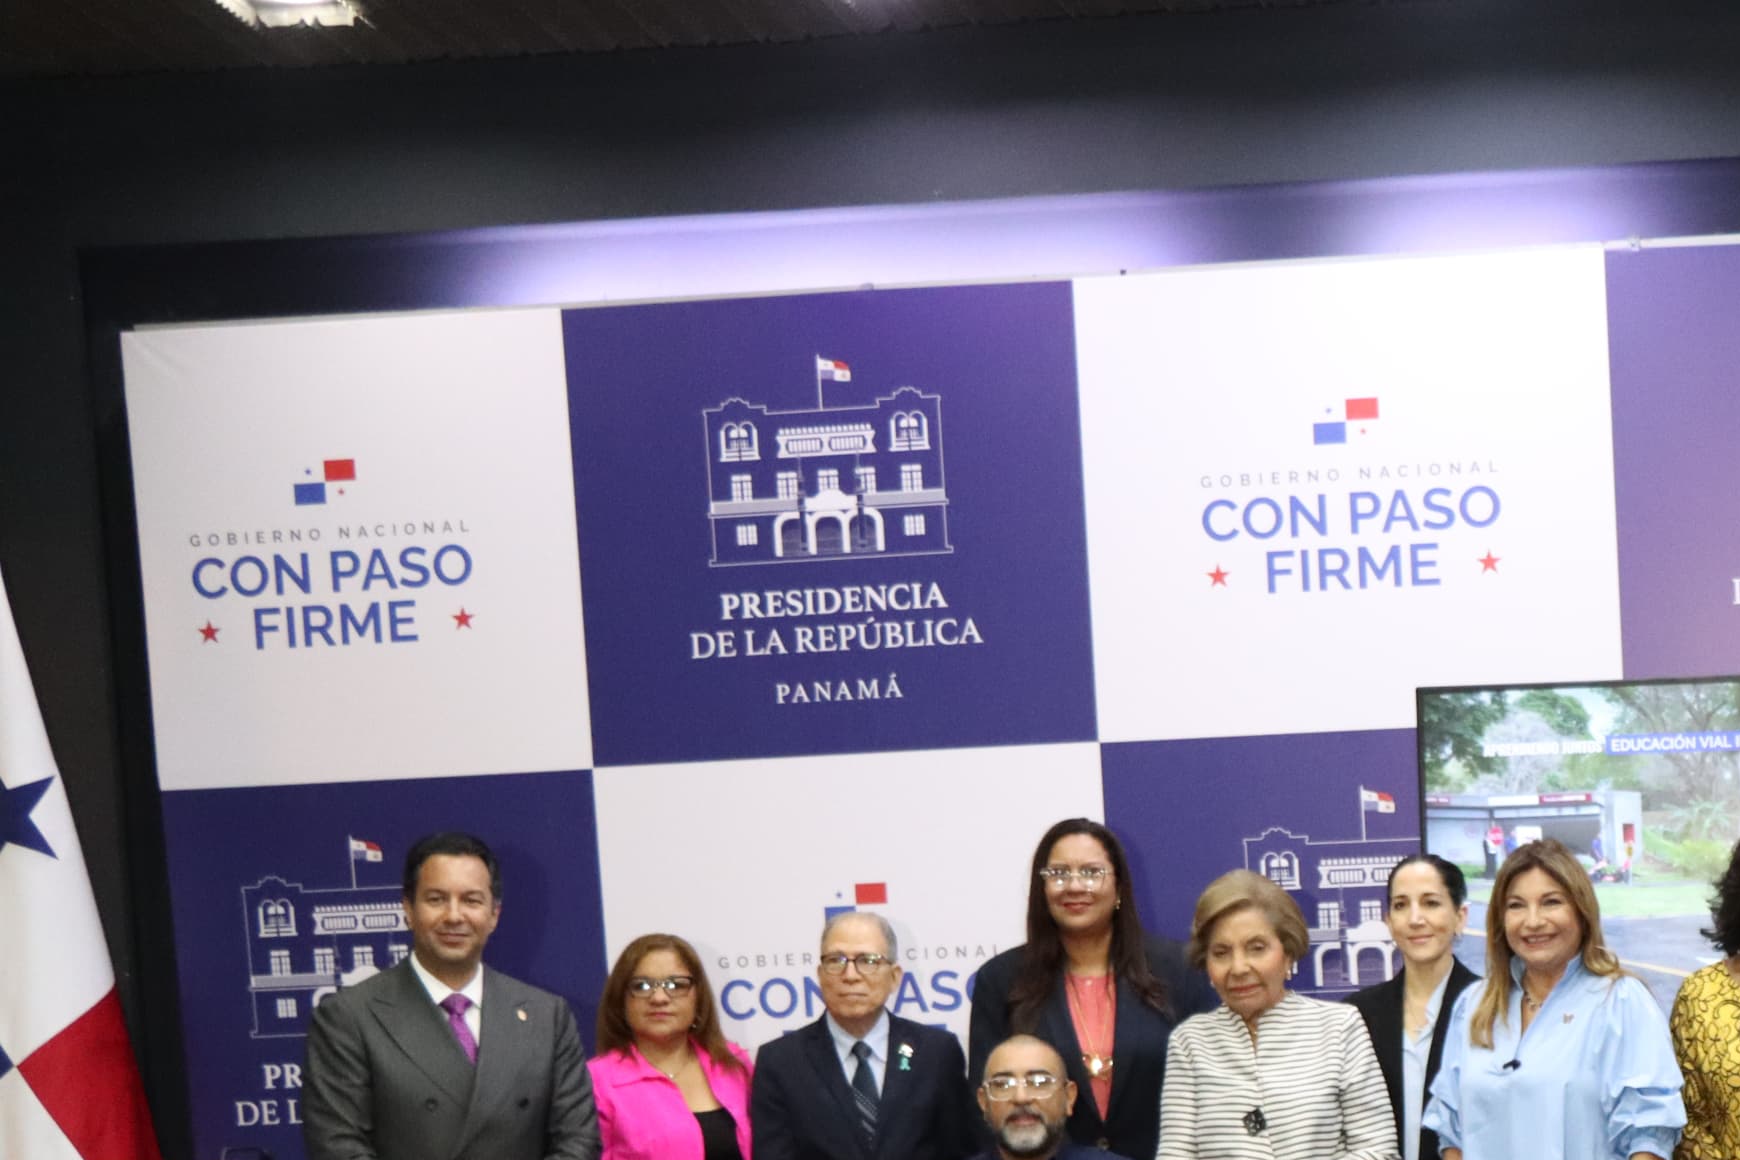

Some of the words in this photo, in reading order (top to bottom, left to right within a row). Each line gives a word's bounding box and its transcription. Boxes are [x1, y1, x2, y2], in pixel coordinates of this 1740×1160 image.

[1200, 468, 1340, 489] GOBIERNO
[1359, 459, 1499, 480] NACIONAL
[1201, 493, 1328, 542] CON
[1349, 485, 1501, 535] PASO
[189, 528, 321, 547] GOBIERNO
[339, 519, 470, 539] NACIONAL
[192, 552, 312, 599] CON
[330, 544, 472, 593] PASO
[1266, 542, 1441, 594] FIRME
[720, 581, 949, 620] PRESIDENCIA
[253, 600, 418, 650] FIRME
[690, 631, 737, 659] DE
[745, 628, 788, 656] LA
[795, 616, 984, 654] REPÚBLICA
[776, 672, 904, 704] PANAMÁ
[1611, 734, 1697, 752] EDUCACIÓN
[1699, 735, 1731, 749] VIAL
[718, 952, 813, 969] GOBIER
[235, 1100, 280, 1127] DE
[287, 1099, 304, 1124] L
